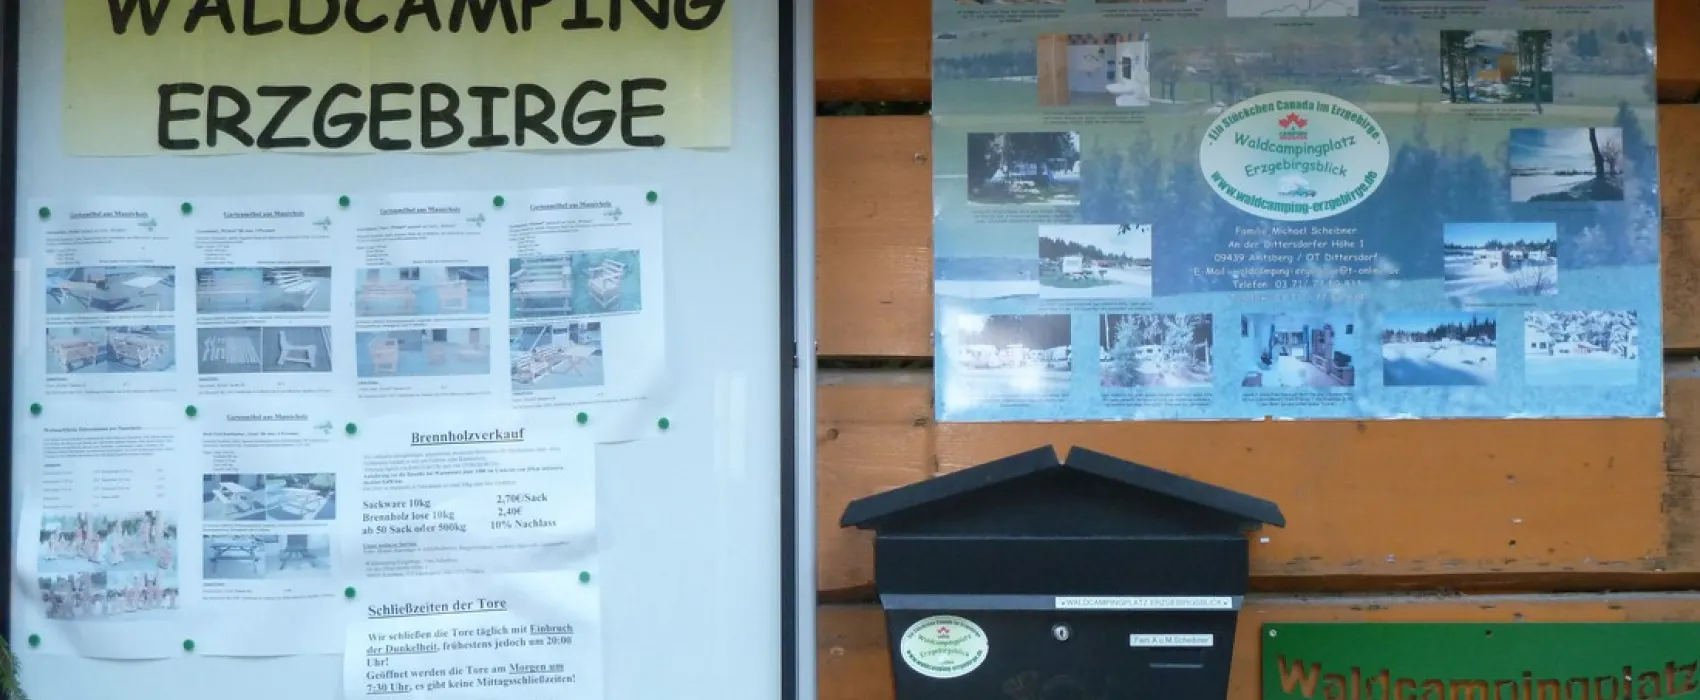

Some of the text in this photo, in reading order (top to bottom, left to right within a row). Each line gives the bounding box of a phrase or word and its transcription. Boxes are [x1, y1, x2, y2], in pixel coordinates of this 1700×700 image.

[156, 78, 668, 151] ERZGEBIRGE
[1222, 102, 1275, 128] Stückchen
[1276, 100, 1315, 111] Canada
[1316, 101, 1330, 112] im
[1331, 104, 1380, 141] Erzgebirge
[1235, 131, 1357, 158] Waldcampingplatz
[1244, 159, 1348, 178] Erzgebirgsblick
[1211, 170, 1378, 214] www.waldcamping-erzgebirge.de
[1272, 226, 1307, 235] Michael
[1311, 226, 1357, 235] Scheibner
[1228, 240, 1240, 249] An
[1244, 240, 1260, 249] der
[1331, 240, 1355, 249] Höhe
[410, 427, 526, 445] Brennholzverkauf
[362, 500, 406, 510] Sackware
[409, 498, 431, 508] 10kg
[362, 507, 522, 522] Brennholz lose 10kg 2,40€
[362, 518, 557, 534] ab 50 Sack oder 500kg 10% Nachlass
[368, 598, 507, 619] Schließzeiten der Tore
[368, 623, 574, 641] Wir schließen die Tore täglich mit Einbruch
[366, 646, 382, 656] der
[386, 643, 440, 655] Dunkelheit,
[443, 640, 492, 650] frühestens
[495, 638, 526, 650] jedoch
[546, 636, 573, 646] 20:00
[366, 657, 389, 667] Uhr!
[366, 669, 408, 680] Geöffnet
[410, 667, 446, 677] werden
[449, 666, 463, 676] die
[465, 666, 489, 675] Tore
[491, 666, 506, 674] am
[509, 663, 546, 675] Morgen
[366, 683, 388, 694] 7:30
[390, 682, 413, 693] Uhr,
[427, 680, 446, 691] gibt
[448, 679, 474, 689] keine
[477, 673, 576, 688] Mittagsschließzeiten!
